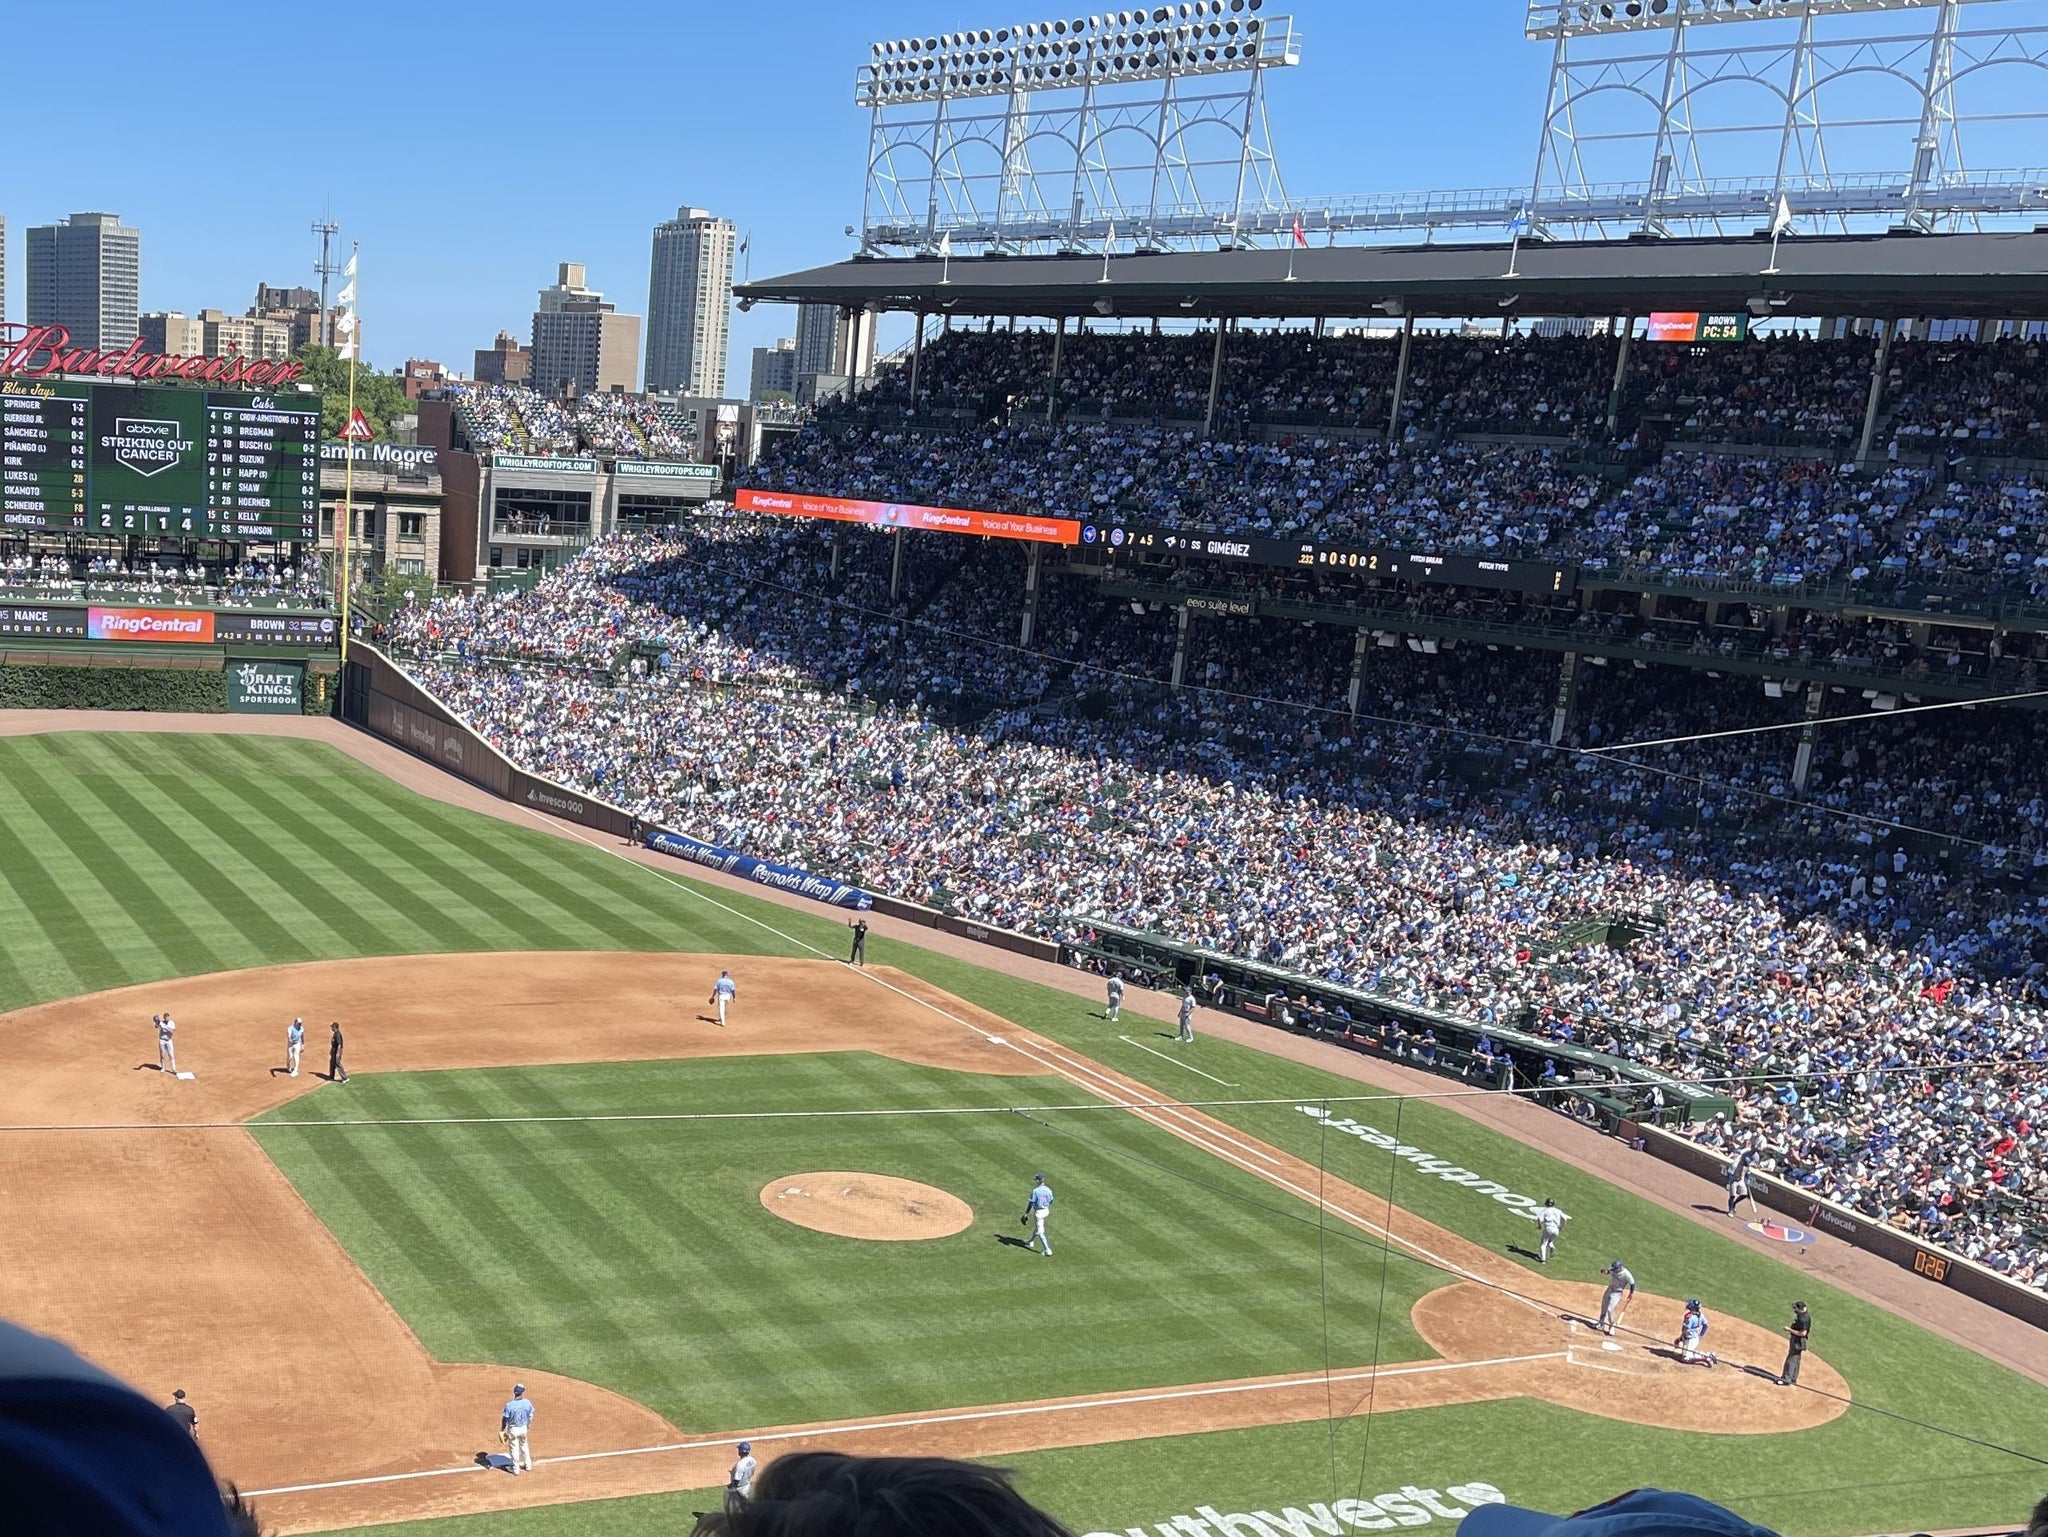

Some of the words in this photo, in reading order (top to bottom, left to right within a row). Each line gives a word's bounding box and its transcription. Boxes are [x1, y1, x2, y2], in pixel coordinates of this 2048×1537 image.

[1708, 316, 1736, 325] BROWN
[1703, 326, 1721, 338] PC:
[1722, 326, 1737, 338] 54
[0, 323, 304, 385] Budweiser
[2, 381, 27, 394] Blue
[30, 383, 55, 400] Jays
[4, 400, 40, 409] SPRINGER
[72, 403, 84, 412] 1-2
[251, 396, 276, 409] Cubs
[4, 413, 34, 423] GUERRERO
[71, 417, 84, 426] 0-2
[210, 411, 216, 420] 4
[223, 412, 233, 420] CF
[239, 413, 290, 424] CROW-ARMSTRONG
[290, 417, 299, 425] (L)
[303, 417, 316, 425] 2-2
[4, 426, 38, 437] SÁNCHEZ
[38, 430, 48, 439] (L)
[71, 431, 84, 440] 0-2
[126, 424, 169, 435] abbvie
[210, 425, 216, 434] 3
[222, 426, 233, 434] 3B
[239, 426, 274, 437] BREGMAN
[304, 430, 315, 439] 1-2
[37, 444, 47, 453] (L)
[71, 445, 84, 455] 0-2
[101, 436, 165, 449] STRIKING
[167, 440, 194, 451] OUT
[207, 438, 218, 447] 29
[223, 440, 232, 448] 1B
[239, 440, 263, 450] BUSCH
[264, 443, 272, 451] (L)
[302, 444, 315, 453] 0-2
[121, 449, 174, 461] CANCER
[207, 453, 217, 461] 27
[222, 454, 233, 462] DH
[239, 454, 265, 464] SUZUKI
[302, 458, 315, 467] 2-3
[373, 444, 434, 463] Moore
[4, 456, 22, 466] KIRK
[71, 460, 84, 469] 0-2
[499, 457, 592, 470] WRIGLEYROOFTOPS.COM
[4, 471, 28, 481] LUKES
[29, 473, 38, 481] (L)
[73, 474, 84, 483] 2B
[209, 467, 215, 476] 8
[222, 467, 232, 477] LF
[238, 468, 259, 478] HAPP
[302, 472, 314, 481] 0-2
[621, 464, 713, 477] WRIGLEYROOFTOPS.COM
[4, 486, 40, 496] OKAMOTO
[209, 481, 215, 490] 6
[222, 482, 232, 491] RF
[238, 483, 260, 492] SHAW
[301, 486, 314, 495] 0-2
[4, 501, 44, 511] SCHNEIDER
[209, 496, 215, 505] 2
[221, 496, 232, 505] 2B
[238, 498, 271, 507] HOERNER
[302, 500, 314, 509] 1-3
[752, 495, 792, 509] RingCentral
[802, 501, 819, 511] Voice
[825, 504, 838, 514] Your
[4, 513, 36, 524] GIMÉNEZ
[36, 517, 46, 526] (L)
[72, 517, 84, 527] 1-1
[101, 514, 111, 527] 2
[124, 515, 134, 528] 2
[159, 517, 167, 530] 1
[181, 518, 192, 531] 4
[207, 510, 216, 519] 15
[223, 511, 230, 520] C
[238, 512, 260, 521] KELLY
[301, 514, 313, 524] 1-2
[922, 512, 970, 527] RingCentral
[208, 524, 214, 533] 7
[221, 525, 231, 534] SS
[237, 525, 273, 535] SWANSON
[301, 528, 313, 537] 1-2
[982, 519, 1000, 530] Voice
[1001, 521, 1009, 531] of
[1009, 522, 1024, 533] Your
[1025, 522, 1057, 535] Business
[1101, 530, 1106, 542] 1
[1127, 532, 1134, 545] 7
[1180, 538, 1186, 549] 0
[1191, 541, 1201, 550] SS
[1207, 540, 1250, 557] GIMÉNEZ
[1298, 554, 1314, 564] .232
[1320, 552, 1327, 562] B
[1329, 552, 1338, 565] 0
[1340, 554, 1347, 564] S
[1349, 554, 1358, 567] 0
[1369, 556, 1378, 569] 2
[1425, 556, 1443, 564] BREAK
[1478, 561, 1494, 570] PITCH
[1495, 563, 1509, 572] TYPE
[1425, 568, 1431, 576] V
[1187, 598, 1206, 609] eero
[1208, 599, 1227, 611] suite
[1229, 601, 1250, 613] level
[14, 610, 48, 621] NANCE
[14, 624, 20, 632] 0
[101, 615, 202, 633] RingCentral
[250, 619, 285, 630] BROWN
[289, 621, 300, 631] 32
[240, 674, 294, 686] DRAFT
[246, 684, 293, 695] KINGS
[239, 696, 297, 704] SPORTSBOOK
[539, 791, 567, 809] Invesco
[653, 835, 696, 858] Reynolds
[698, 846, 723, 868] Wrap
[752, 863, 802, 889] Reynolds
[800, 876, 832, 899] Wrap
[1819, 1210, 1857, 1233] Advocate
